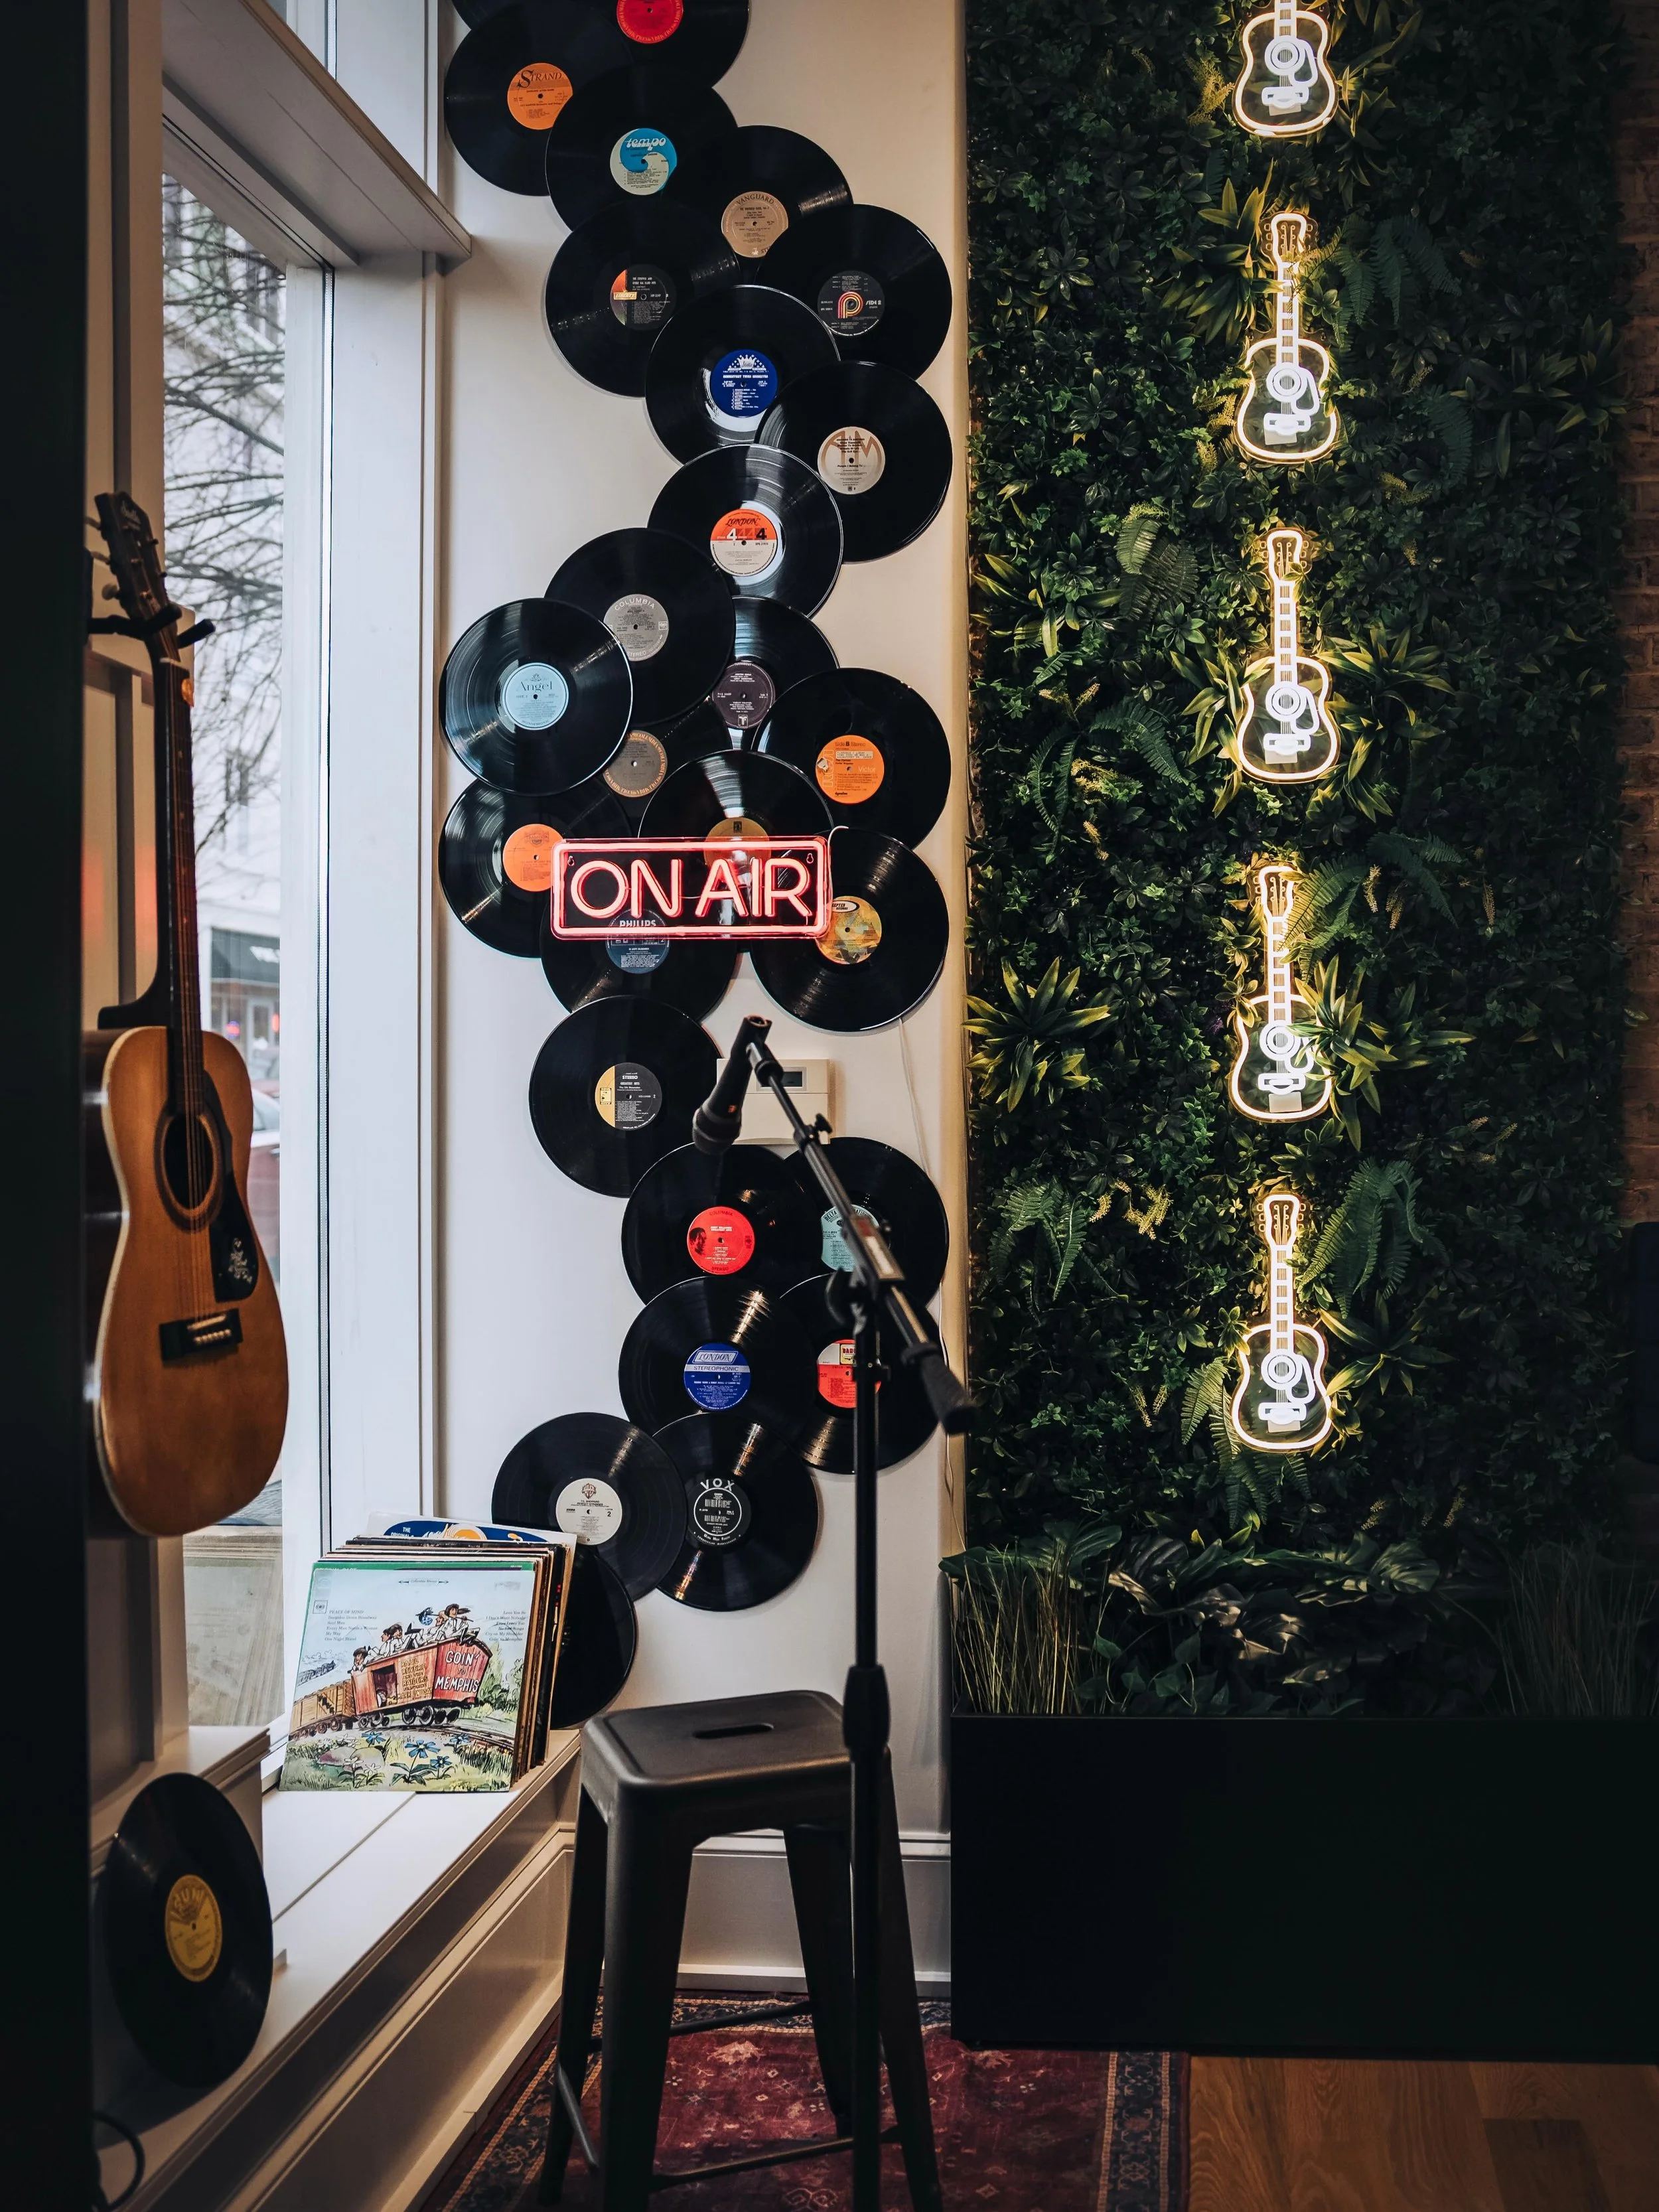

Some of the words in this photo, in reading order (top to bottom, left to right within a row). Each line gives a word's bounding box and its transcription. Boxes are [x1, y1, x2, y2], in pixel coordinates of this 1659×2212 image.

[517, 70, 562, 88] STRAND
[624, 137, 666, 151] tempo
[736, 194, 774, 206] VANGUARD
[725, 518, 758, 527] LONDON
[614, 597, 655, 611] COLUMBIA
[521, 681, 552, 692] Angel
[571, 859, 682, 919] ON
[695, 858, 812, 918] AIR
[824, 1210, 837, 1222] DELTA
[699, 1353, 733, 1362] LONDON
[700, 1478, 735, 1492] VOX
[446, 1651, 480, 1666] GOIN'
[402, 1663, 426, 1674] REVERE
[403, 1676, 428, 1686] RAIDERS
[435, 1676, 479, 1693] MEMPHIS
